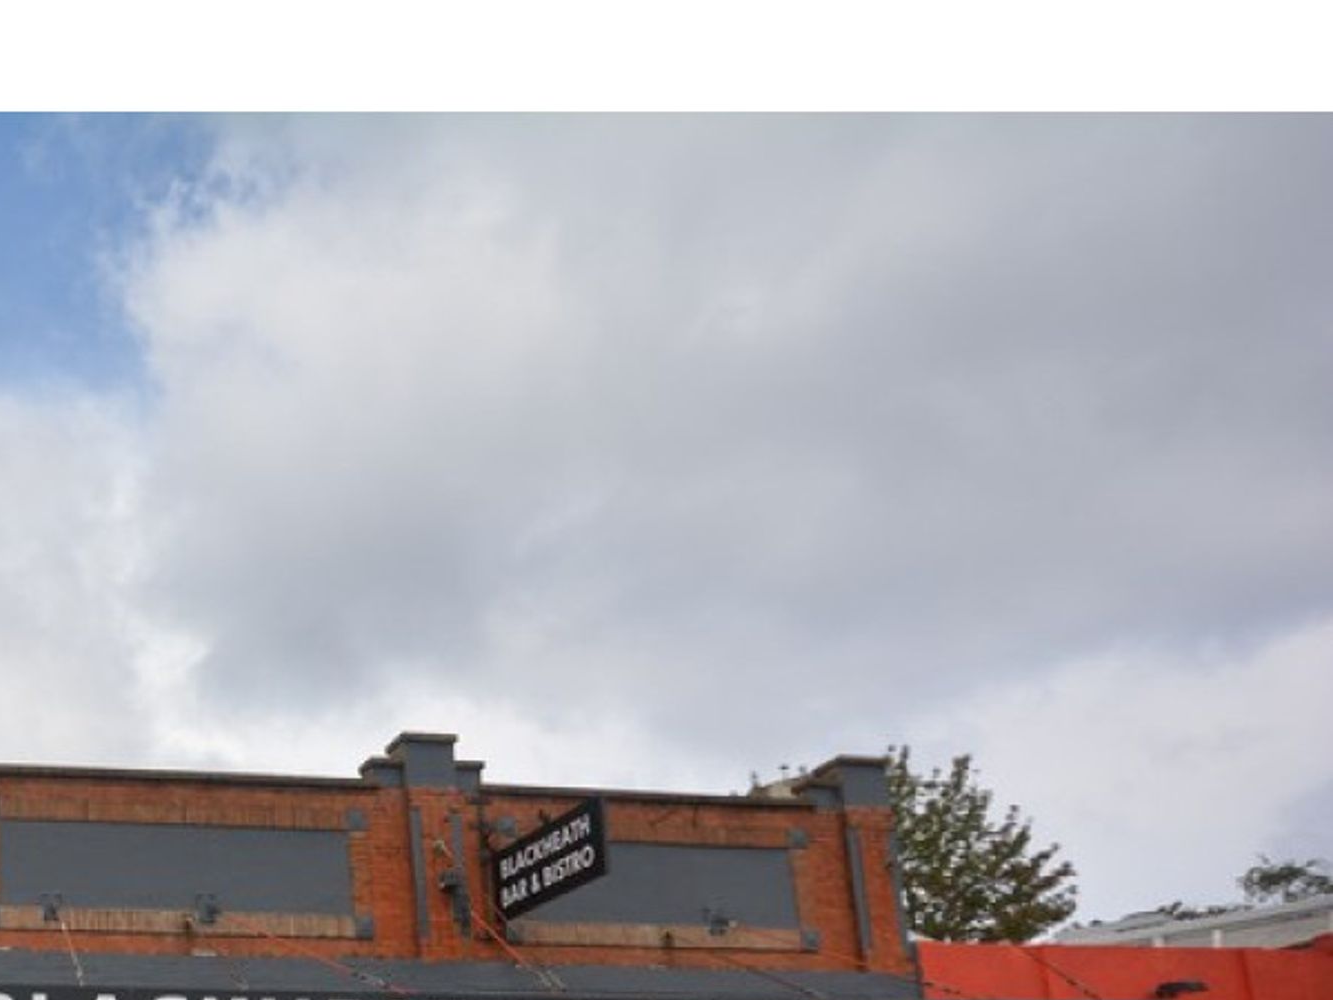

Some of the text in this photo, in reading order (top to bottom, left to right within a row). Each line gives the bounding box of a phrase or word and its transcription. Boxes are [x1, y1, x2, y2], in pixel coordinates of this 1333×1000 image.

[499, 813, 591, 880] BLACKHEATH
[501, 845, 596, 909] BAR & BISTRO
